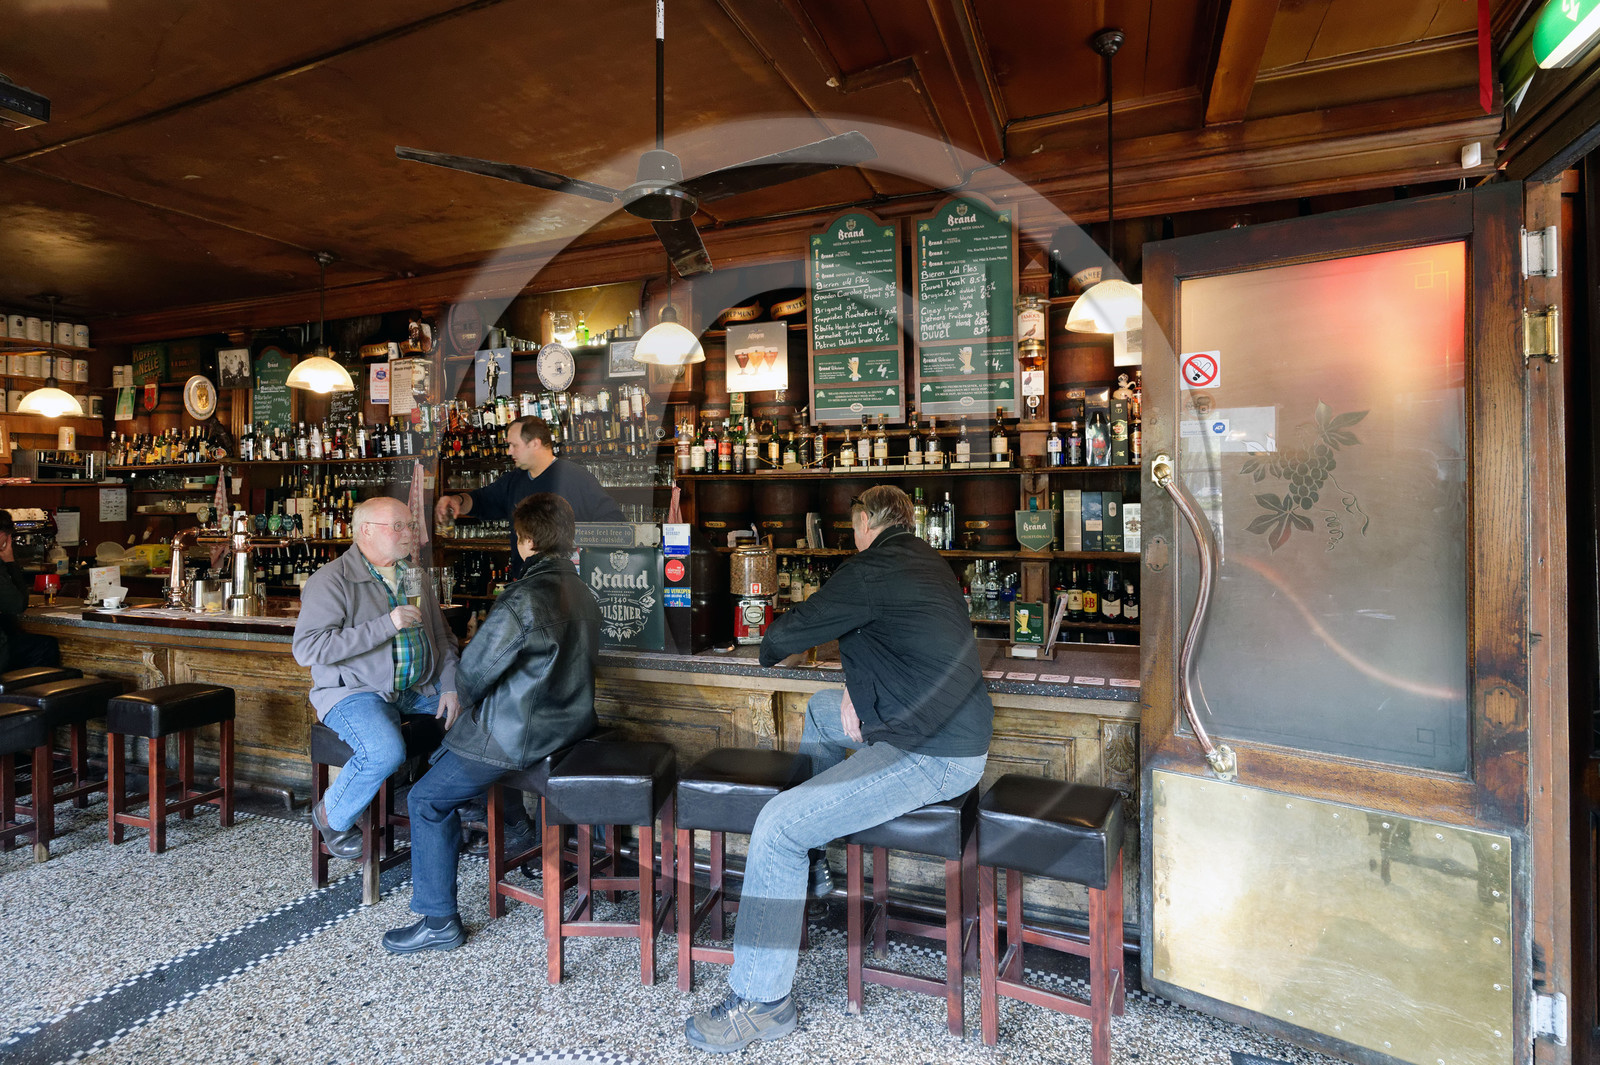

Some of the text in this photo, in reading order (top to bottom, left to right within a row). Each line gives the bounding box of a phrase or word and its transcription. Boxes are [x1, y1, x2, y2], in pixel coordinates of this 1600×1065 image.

[948, 214, 976, 226] Brand
[838, 228, 864, 240] Brand
[815, 304, 842, 314] Brigand
[815, 341, 836, 350] Petrus
[1023, 522, 1047, 531] Brand
[591, 566, 649, 590] Brand
